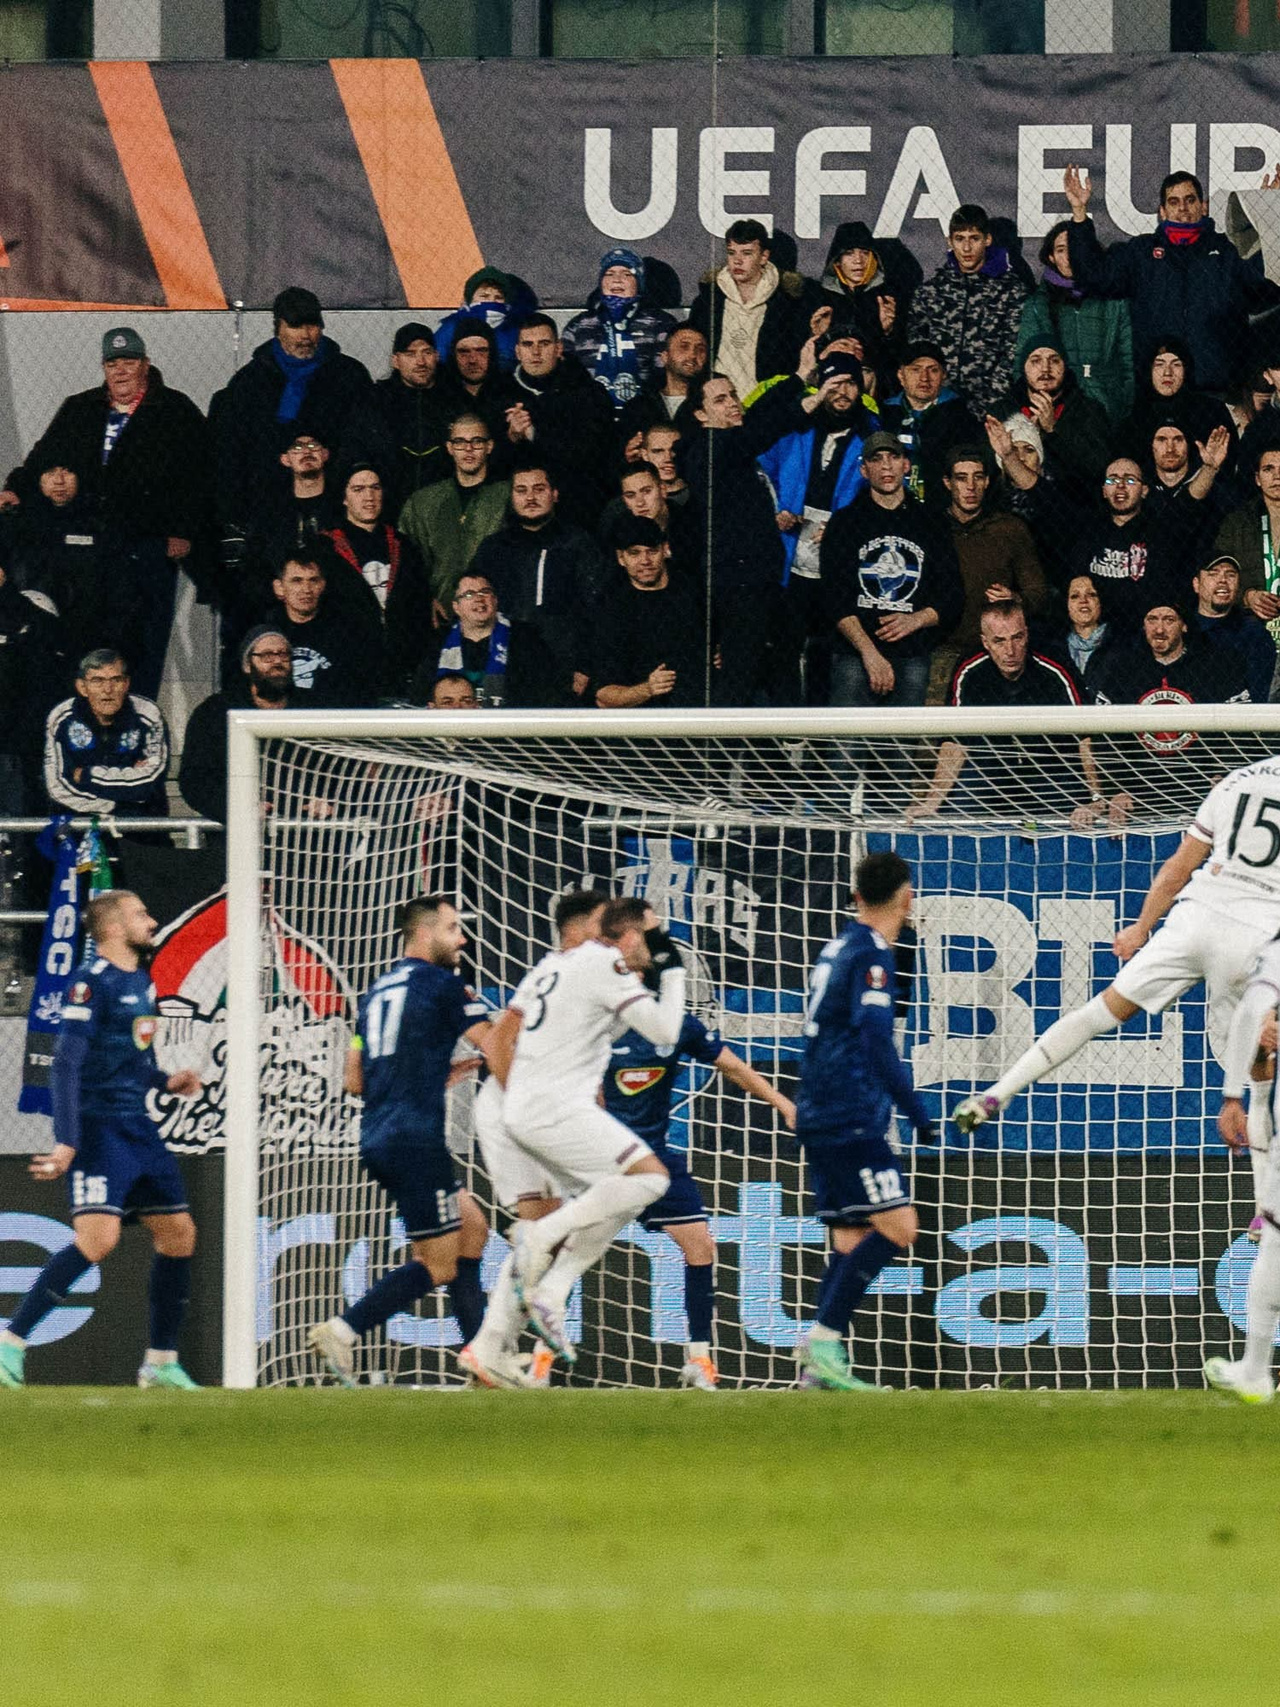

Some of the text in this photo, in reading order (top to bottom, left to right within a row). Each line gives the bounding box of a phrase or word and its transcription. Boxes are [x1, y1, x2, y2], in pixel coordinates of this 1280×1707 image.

[583, 126, 960, 240] UEFA
[46, 867, 78, 977] TSC
[366, 986, 408, 1060] 17
